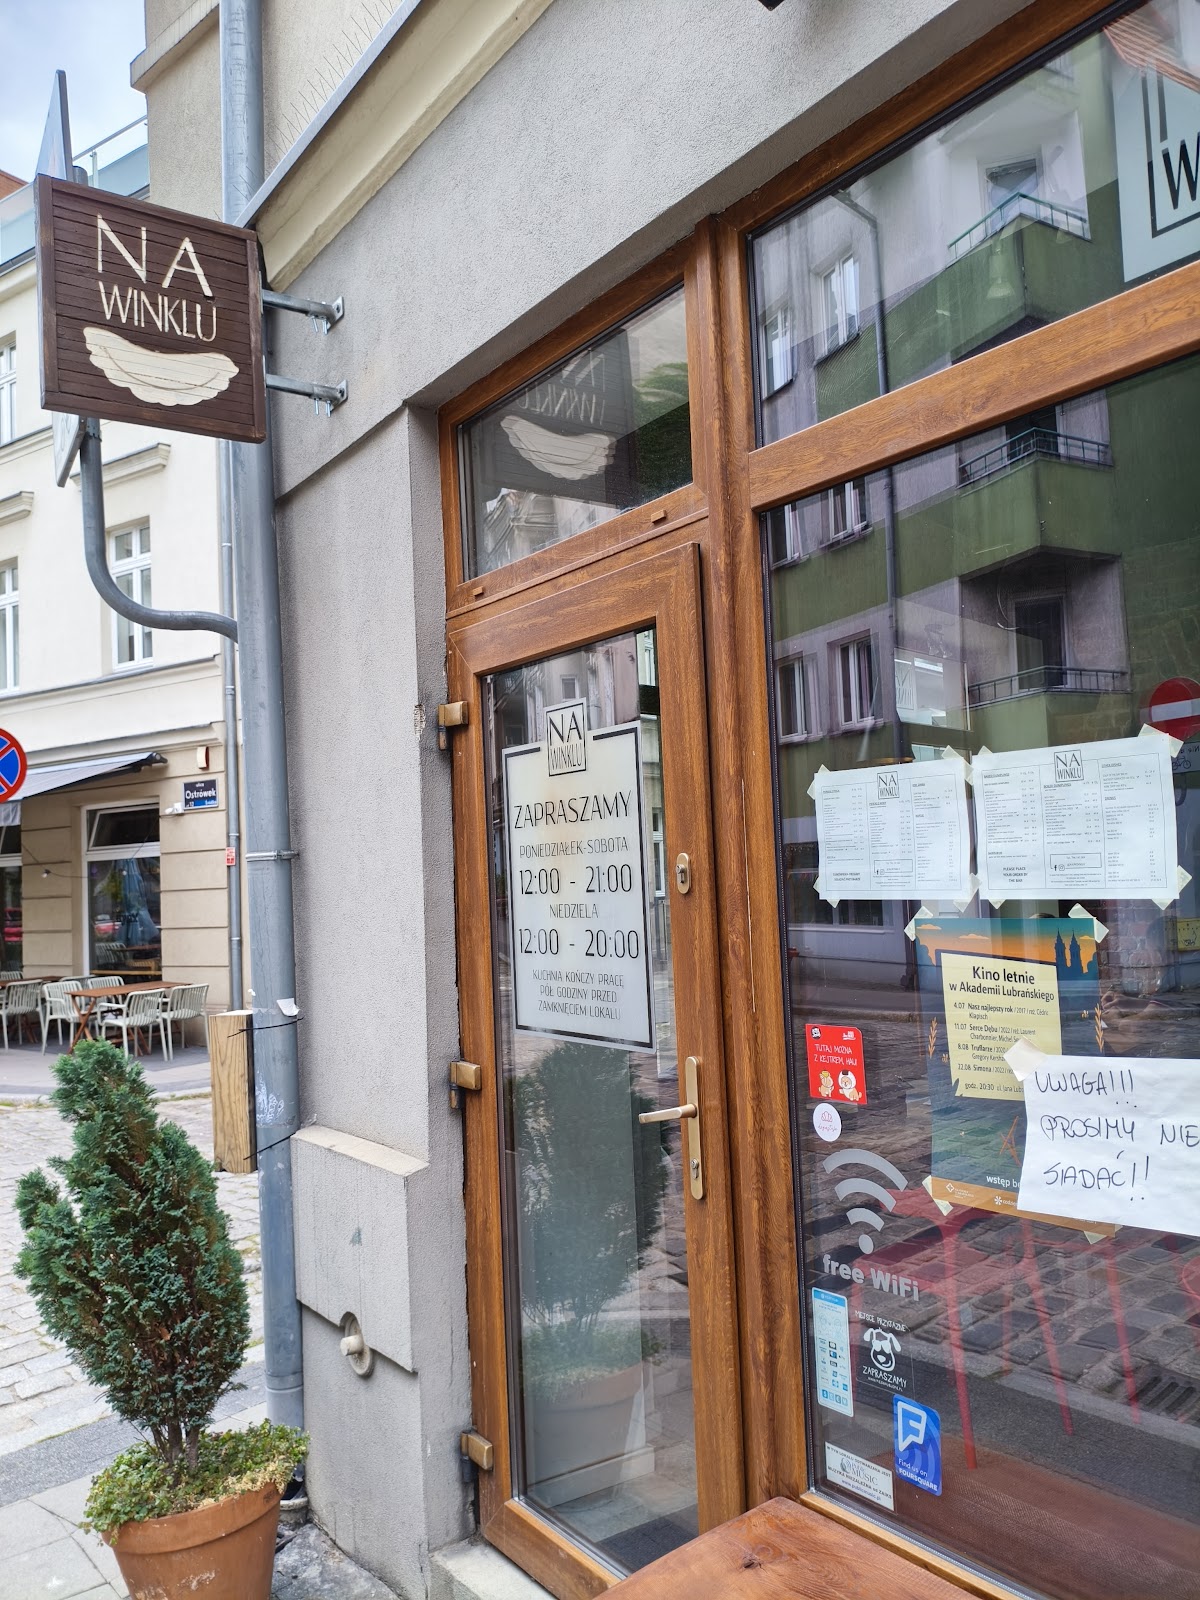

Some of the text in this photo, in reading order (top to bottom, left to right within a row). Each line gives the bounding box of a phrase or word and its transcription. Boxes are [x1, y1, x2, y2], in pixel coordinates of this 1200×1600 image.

[97, 214, 213, 297] NA
[98, 280, 216, 341] WINKLU
[549, 711, 582, 746] NA
[550, 743, 583, 770] WINKLU
[1056, 753, 1081, 768] NA
[879, 774, 897, 788] NA
[1057, 766, 1082, 780] WINKLU
[185, 788, 216, 799] Ostrówek
[514, 790, 631, 829] ZAPRASZAMY
[520, 836, 628, 859] PONIEDZIAŁEK-SOBOTA
[519, 868, 560, 895] 12:00
[585, 864, 633, 893] 21:00
[550, 903, 599, 919] NIEDZIELA
[519, 928, 559, 955] 12:00
[585, 929, 640, 959] 20:00
[532, 969, 625, 989] KUCHNIA KOŃCZY PRACĘ
[972, 965, 1035, 984] Kino letnie
[540, 982, 617, 1003] PÓŁ GODZINY PRZED
[949, 981, 1055, 1002] w Akademii Lubrańskiego
[538, 1000, 621, 1020] ZAMKNIĘCIEM LOKALU
[968, 1003, 980, 1011] Nasz
[981, 1004, 1004, 1013] najlepszy
[1005, 1005, 1013, 1013] rok
[969, 1012, 989, 1020] Klapisch
[984, 1025, 998, 1033] Dębu
[814, 1043, 832, 1054] TUTAJ
[957, 1043, 969, 1051] 8.08
[971, 1044, 993, 1053] Truflarze
[972, 1052, 989, 1061] Gregory
[973, 1063, 992, 1072] Simona
[965, 1082, 978, 1090] godz.
[979, 1082, 995, 1091] 20:30
[1035, 1070, 1137, 1108] UWAGA!!!
[1040, 1114, 1200, 1147] PROSIMY NIE
[986, 1175, 1011, 1187] wstęp
[1043, 1150, 1149, 1201] SIADAĆ!!
[822, 1254, 920, 1301] free WiFi
[862, 1365, 907, 1388] ZAPRASZAMY
[827, 1466, 845, 1478] MUZYKA
[898, 1458, 911, 1469] Find
[852, 1466, 879, 1486] MUSIC
[899, 1468, 938, 1492] FOURSQUARE
